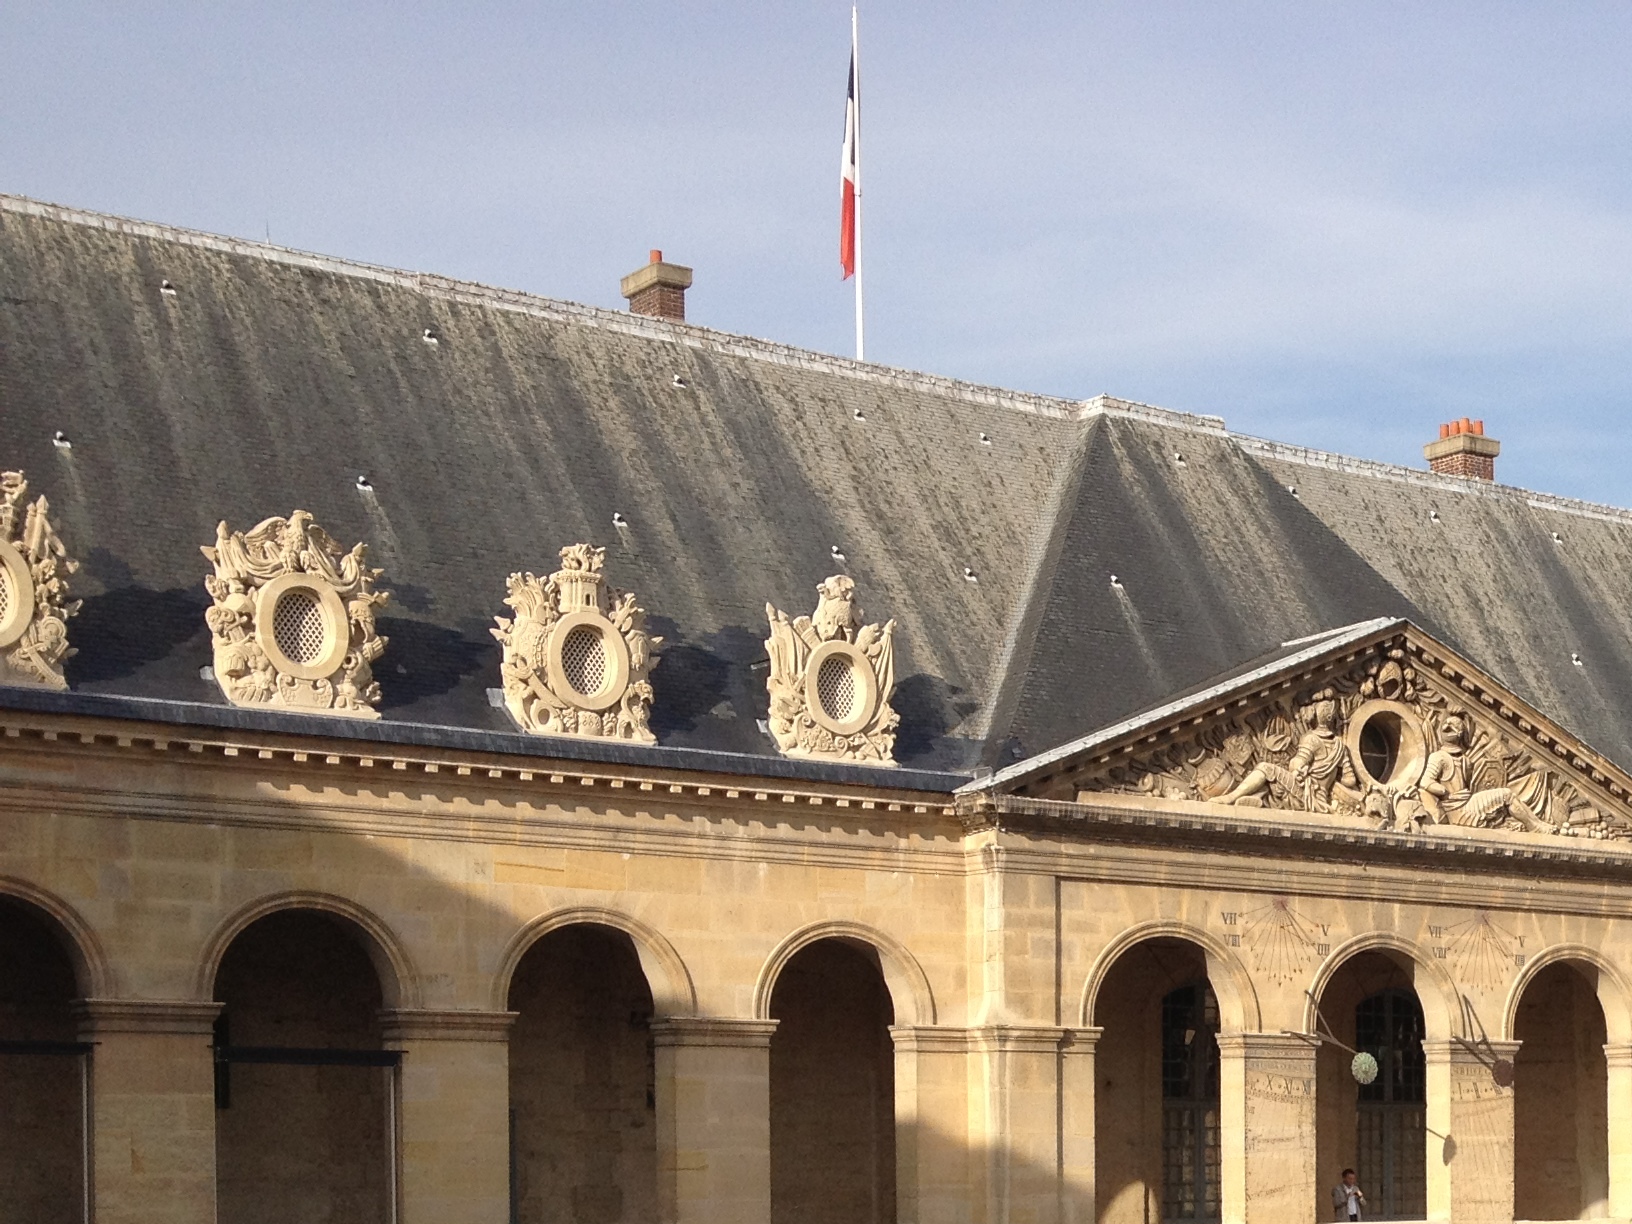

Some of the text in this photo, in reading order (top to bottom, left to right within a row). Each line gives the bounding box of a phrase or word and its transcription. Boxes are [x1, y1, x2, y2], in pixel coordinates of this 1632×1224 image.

[1221, 912, 1237, 925] VII
[1321, 924, 1331, 936] V
[1518, 935, 1526, 947] V
